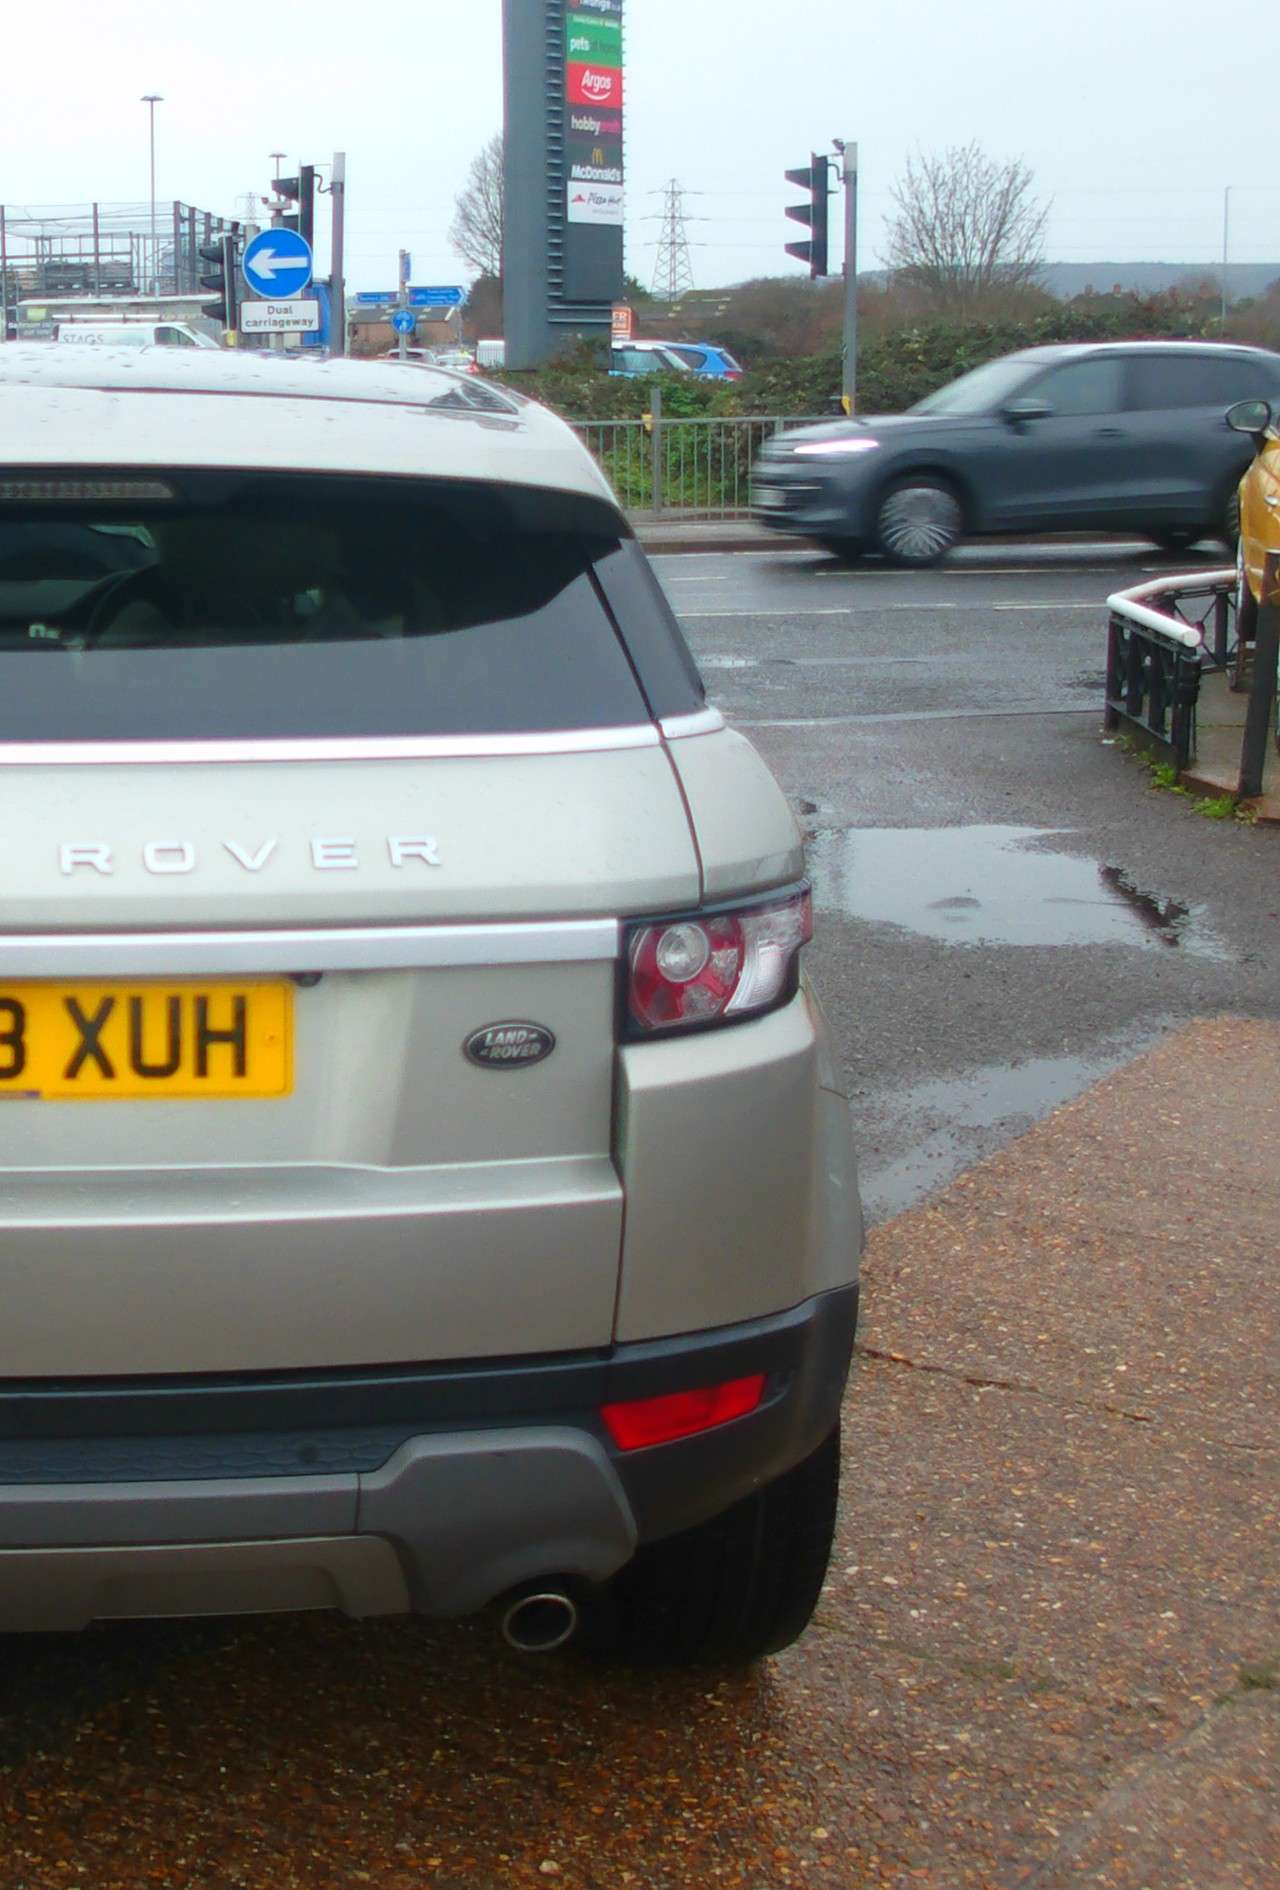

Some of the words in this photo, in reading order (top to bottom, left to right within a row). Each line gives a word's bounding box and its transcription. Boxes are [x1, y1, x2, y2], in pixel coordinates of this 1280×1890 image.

[570, 37, 590, 52] pets
[581, 69, 611, 93] Argos
[266, 305, 294, 315] Dual
[244, 317, 314, 329] carriageway
[58, 834, 442, 876] ROVER
[61, 994, 247, 1080] XUH
[485, 1030, 528, 1046] LAND
[489, 1042, 542, 1058] ROVER
